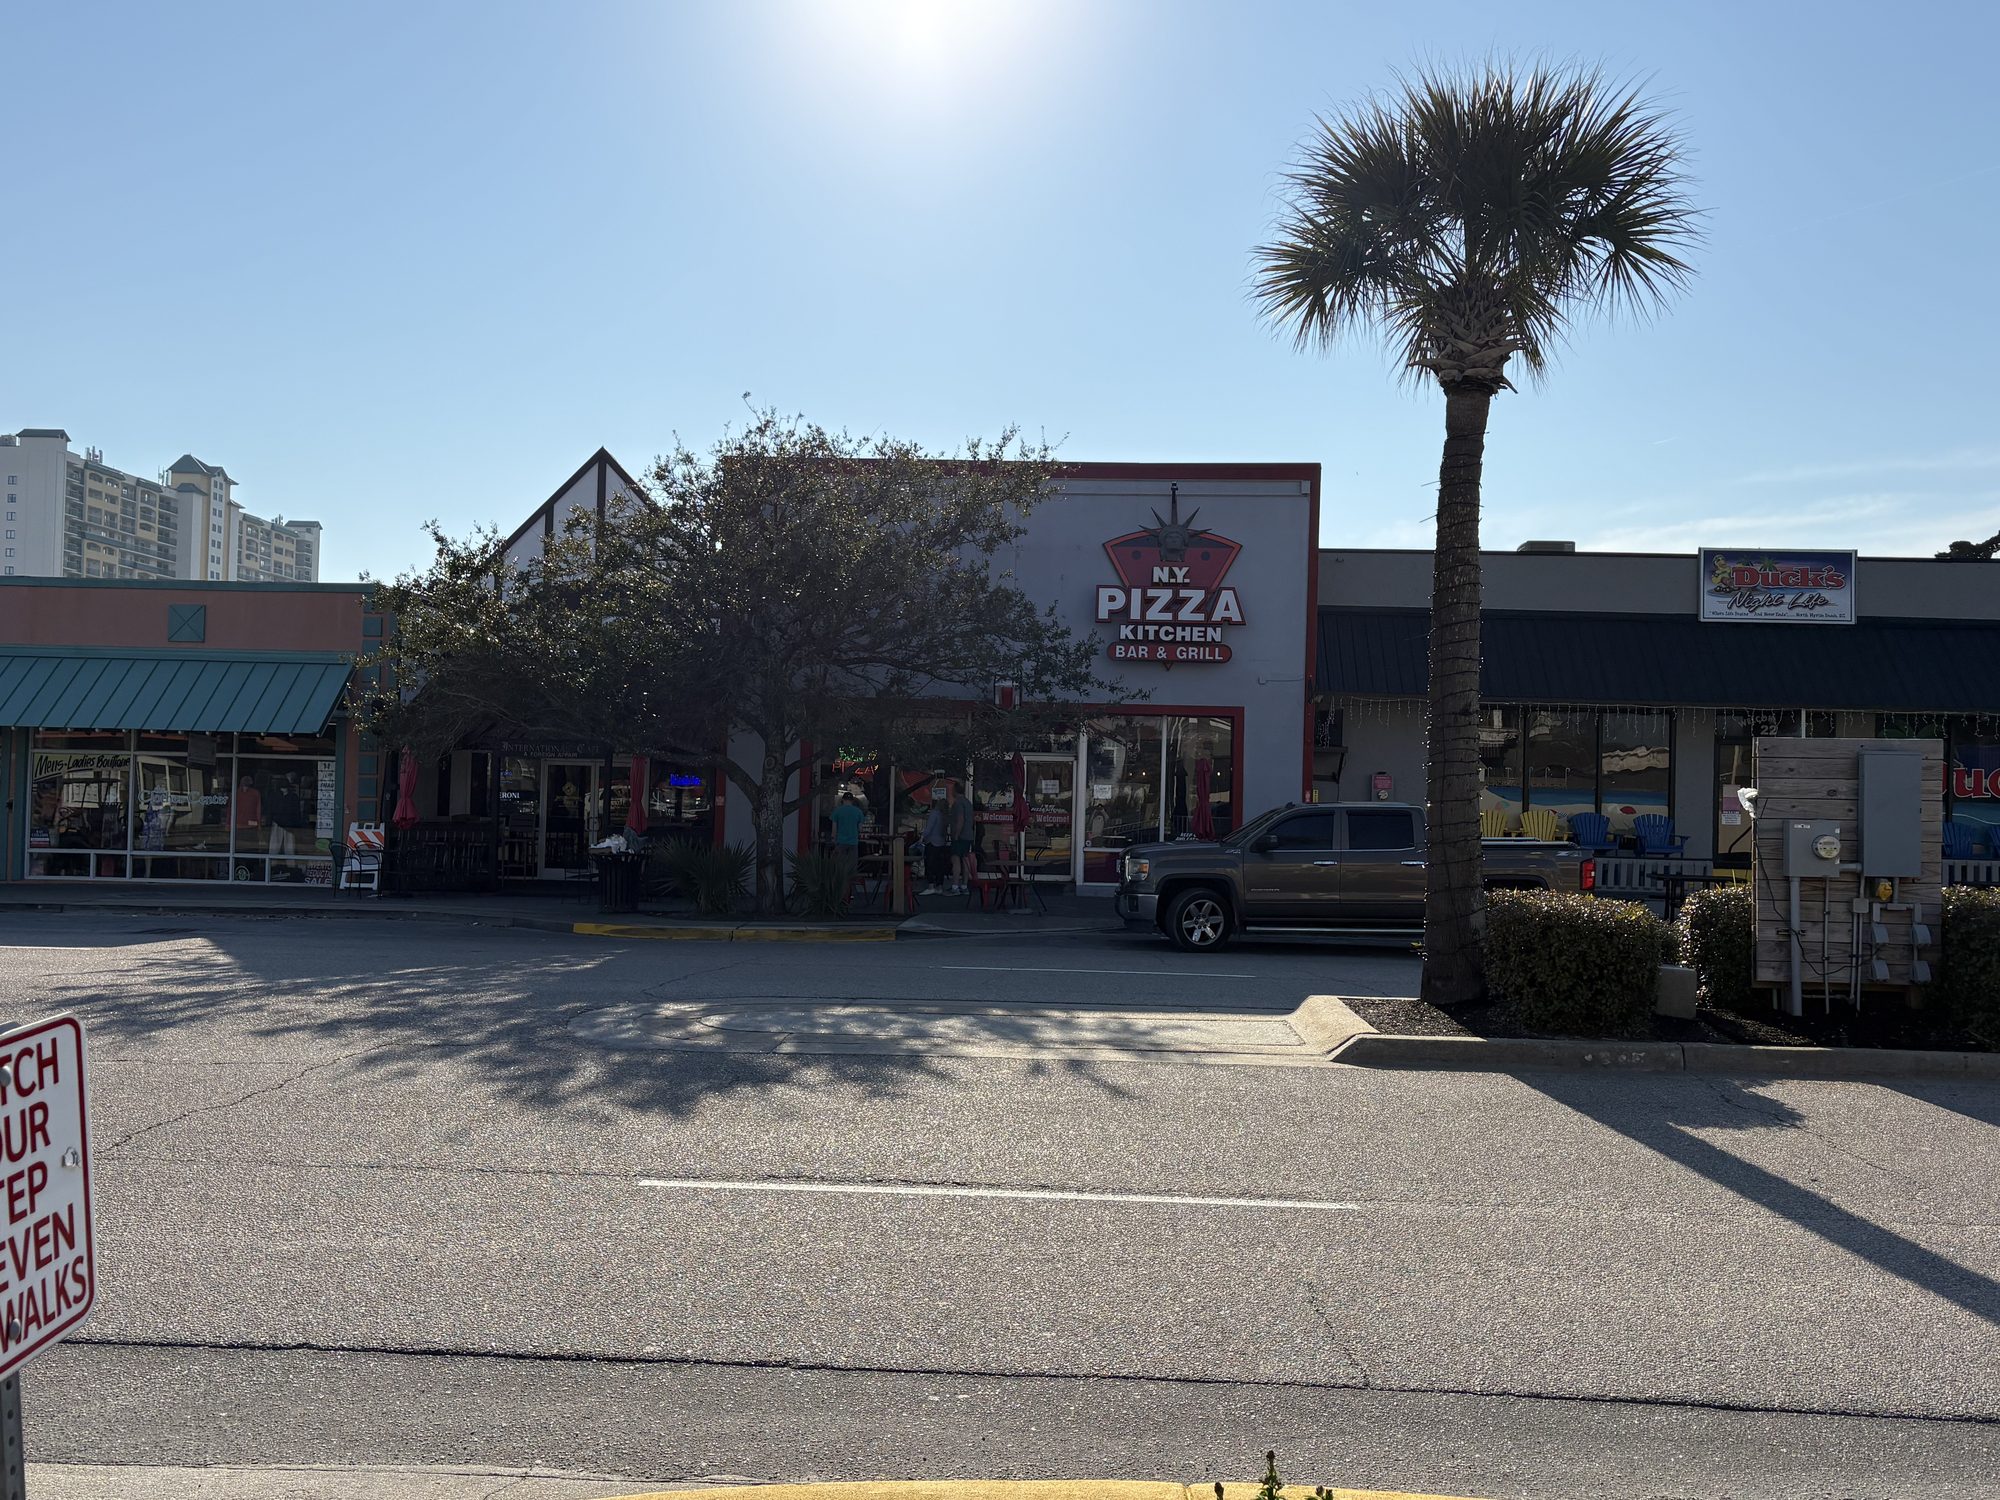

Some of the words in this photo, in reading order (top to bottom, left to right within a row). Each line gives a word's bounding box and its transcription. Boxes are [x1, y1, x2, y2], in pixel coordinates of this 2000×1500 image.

[1152, 566, 1191, 584] N.Y.
[1731, 565, 1847, 589] Duck's
[1097, 587, 1244, 623] PIZZA
[1727, 591, 1785, 612] Night
[1788, 592, 1829, 609] Life
[1119, 625, 1222, 643] KITCHEN
[1115, 645, 1148, 659] BAR
[1156, 646, 1167, 659] &
[1176, 646, 1224, 660] GRILL
[1036, 814, 1070, 823] Welcome!
[304, 877, 333, 886] SALE
[0, 1101, 51, 1164] UR
[0, 1161, 49, 1226] EP
